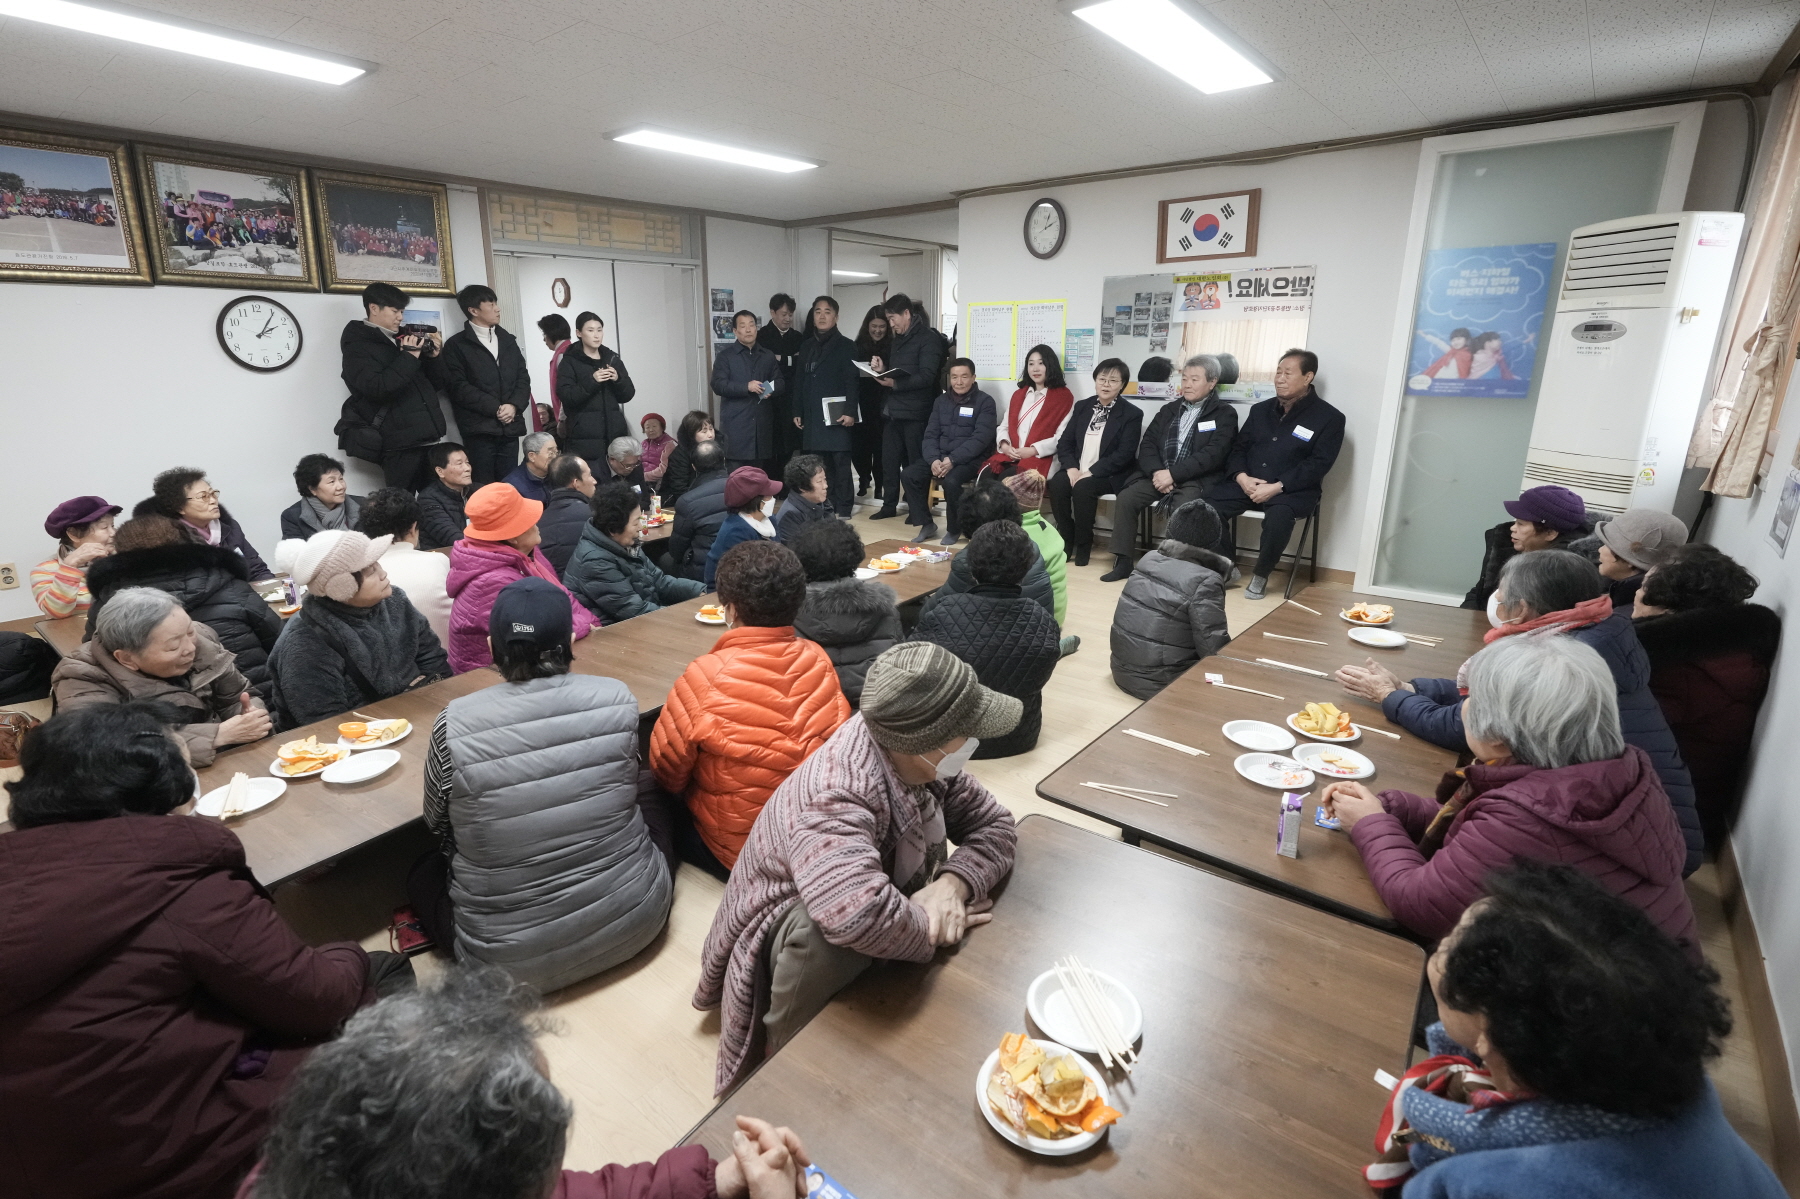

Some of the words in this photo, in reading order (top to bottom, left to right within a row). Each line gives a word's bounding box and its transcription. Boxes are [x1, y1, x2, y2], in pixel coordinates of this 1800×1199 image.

[1470, 278, 1488, 286] 우리
[238, 308, 248, 318] 11
[252, 304, 262, 313] 12
[230, 318, 240, 327] 10
[280, 317, 287, 326] 2
[226, 330, 233, 340] 9
[288, 330, 294, 339] 3
[234, 343, 241, 352] 8
[285, 342, 290, 350] 4
[248, 353, 253, 362] 7
[263, 356, 269, 364] 6
[277, 352, 283, 361] 5
